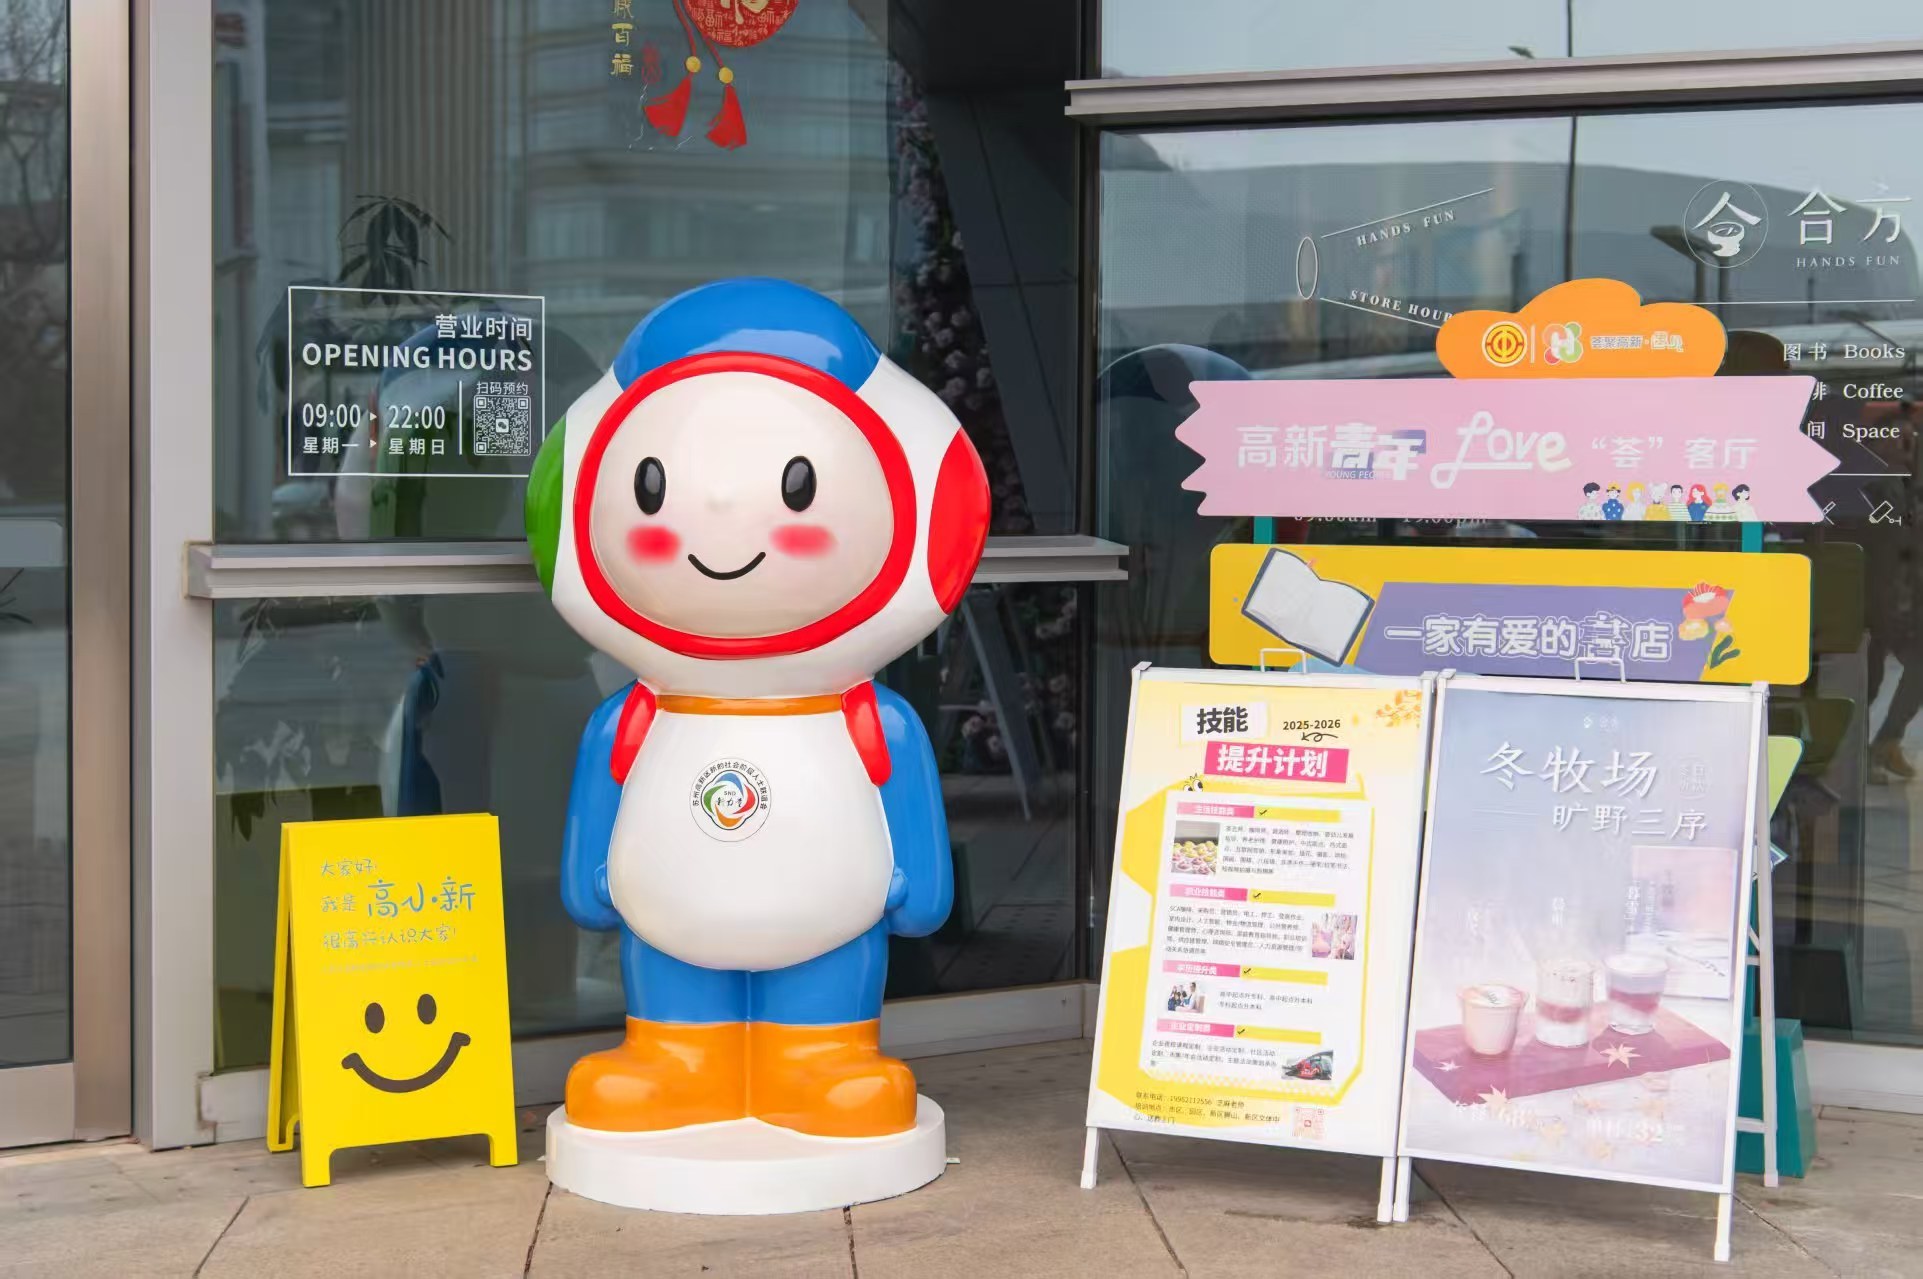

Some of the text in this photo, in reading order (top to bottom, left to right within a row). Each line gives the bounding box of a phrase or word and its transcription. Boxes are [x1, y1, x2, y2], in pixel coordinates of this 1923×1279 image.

[1787, 177, 1912, 246] 合方
[1356, 209, 1456, 248] HANDS FUN
[1796, 255, 1900, 268] HANDS FUN
[1351, 290, 1402, 311] STORE
[435, 313, 532, 341] 营业时间
[302, 342, 532, 371] OPENING HOURS
[1783, 342, 1906, 361] 图书 Books
[476, 381, 529, 395] 扫码预约
[1843, 383, 1904, 399] Coffee
[302, 403, 446, 430] 09:00 22:00
[302, 436, 446, 456] 星期一 星期日
[1842, 423, 1901, 443] Space
[1429, 409, 1573, 489] Love
[1683, 437, 1760, 470] 客厅
[1196, 706, 1249, 735] 技能
[1282, 719, 1341, 731] 2025-2026
[1217, 744, 1329, 778] 提升计划
[1479, 741, 1660, 798] 冬牧场
[1552, 801, 1707, 841] 旷野三序
